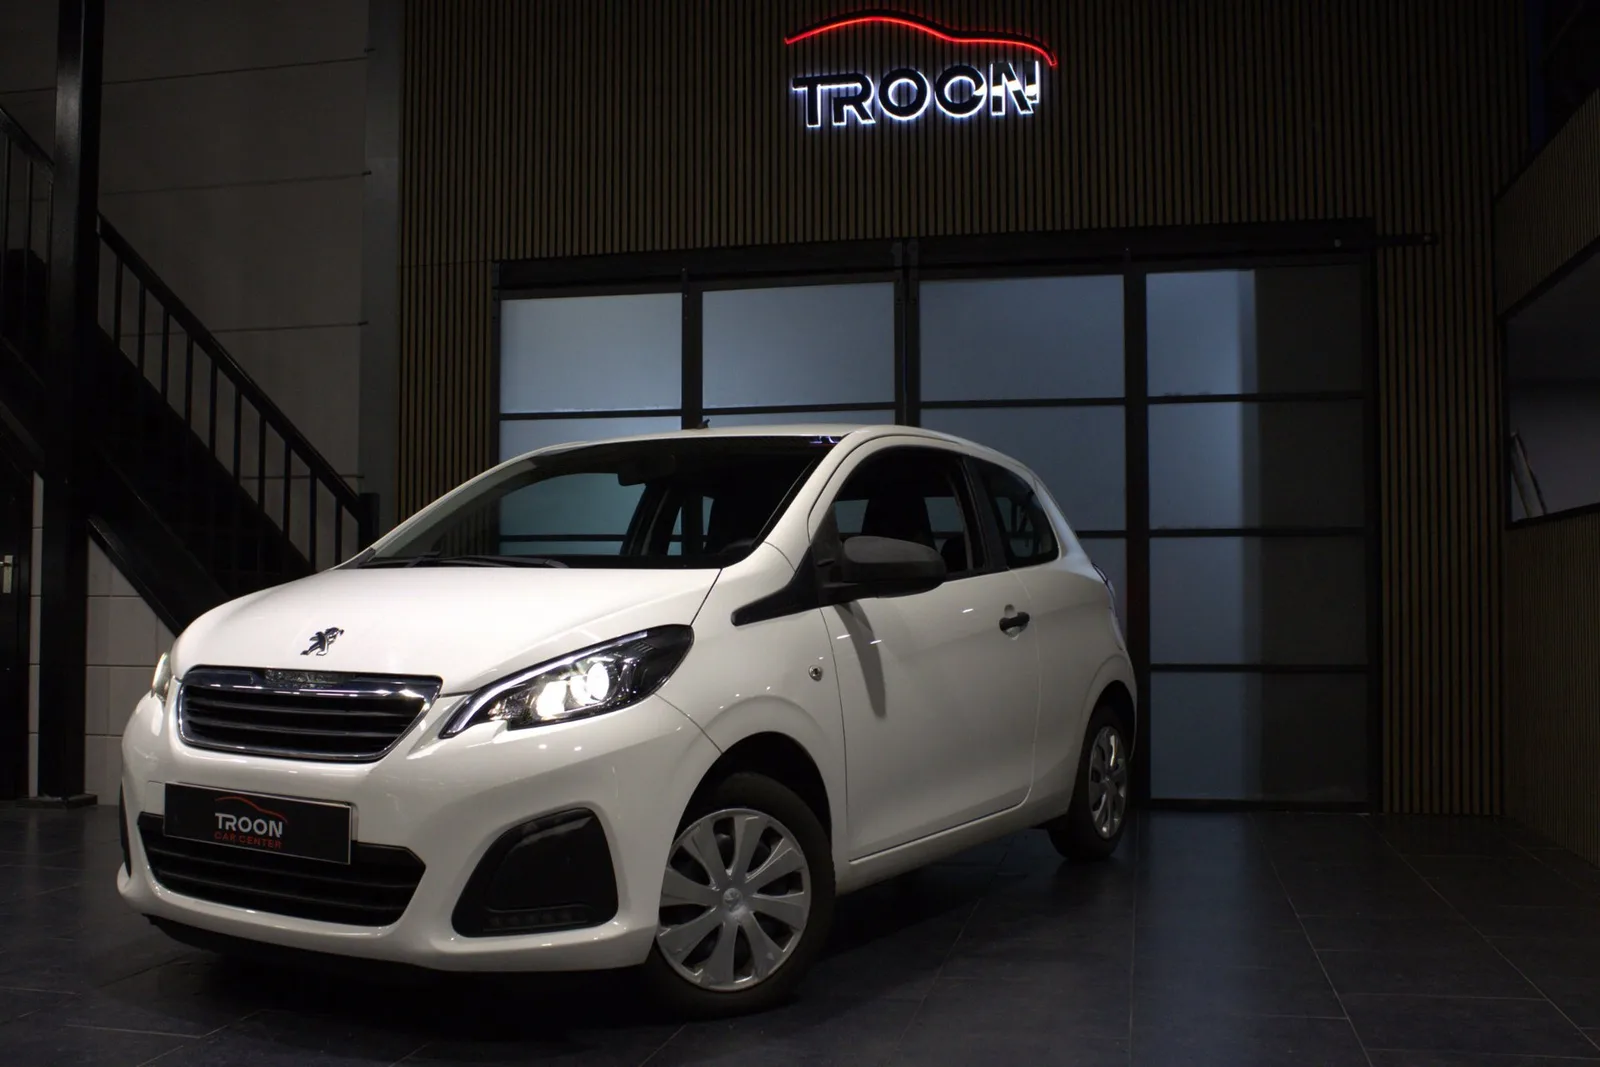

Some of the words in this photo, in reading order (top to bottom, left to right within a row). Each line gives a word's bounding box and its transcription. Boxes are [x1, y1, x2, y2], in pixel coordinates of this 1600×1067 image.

[792, 60, 1039, 127] TROON
[215, 812, 283, 838] TROON
[214, 831, 236, 842] CAR
[239, 834, 283, 849] CENTER
